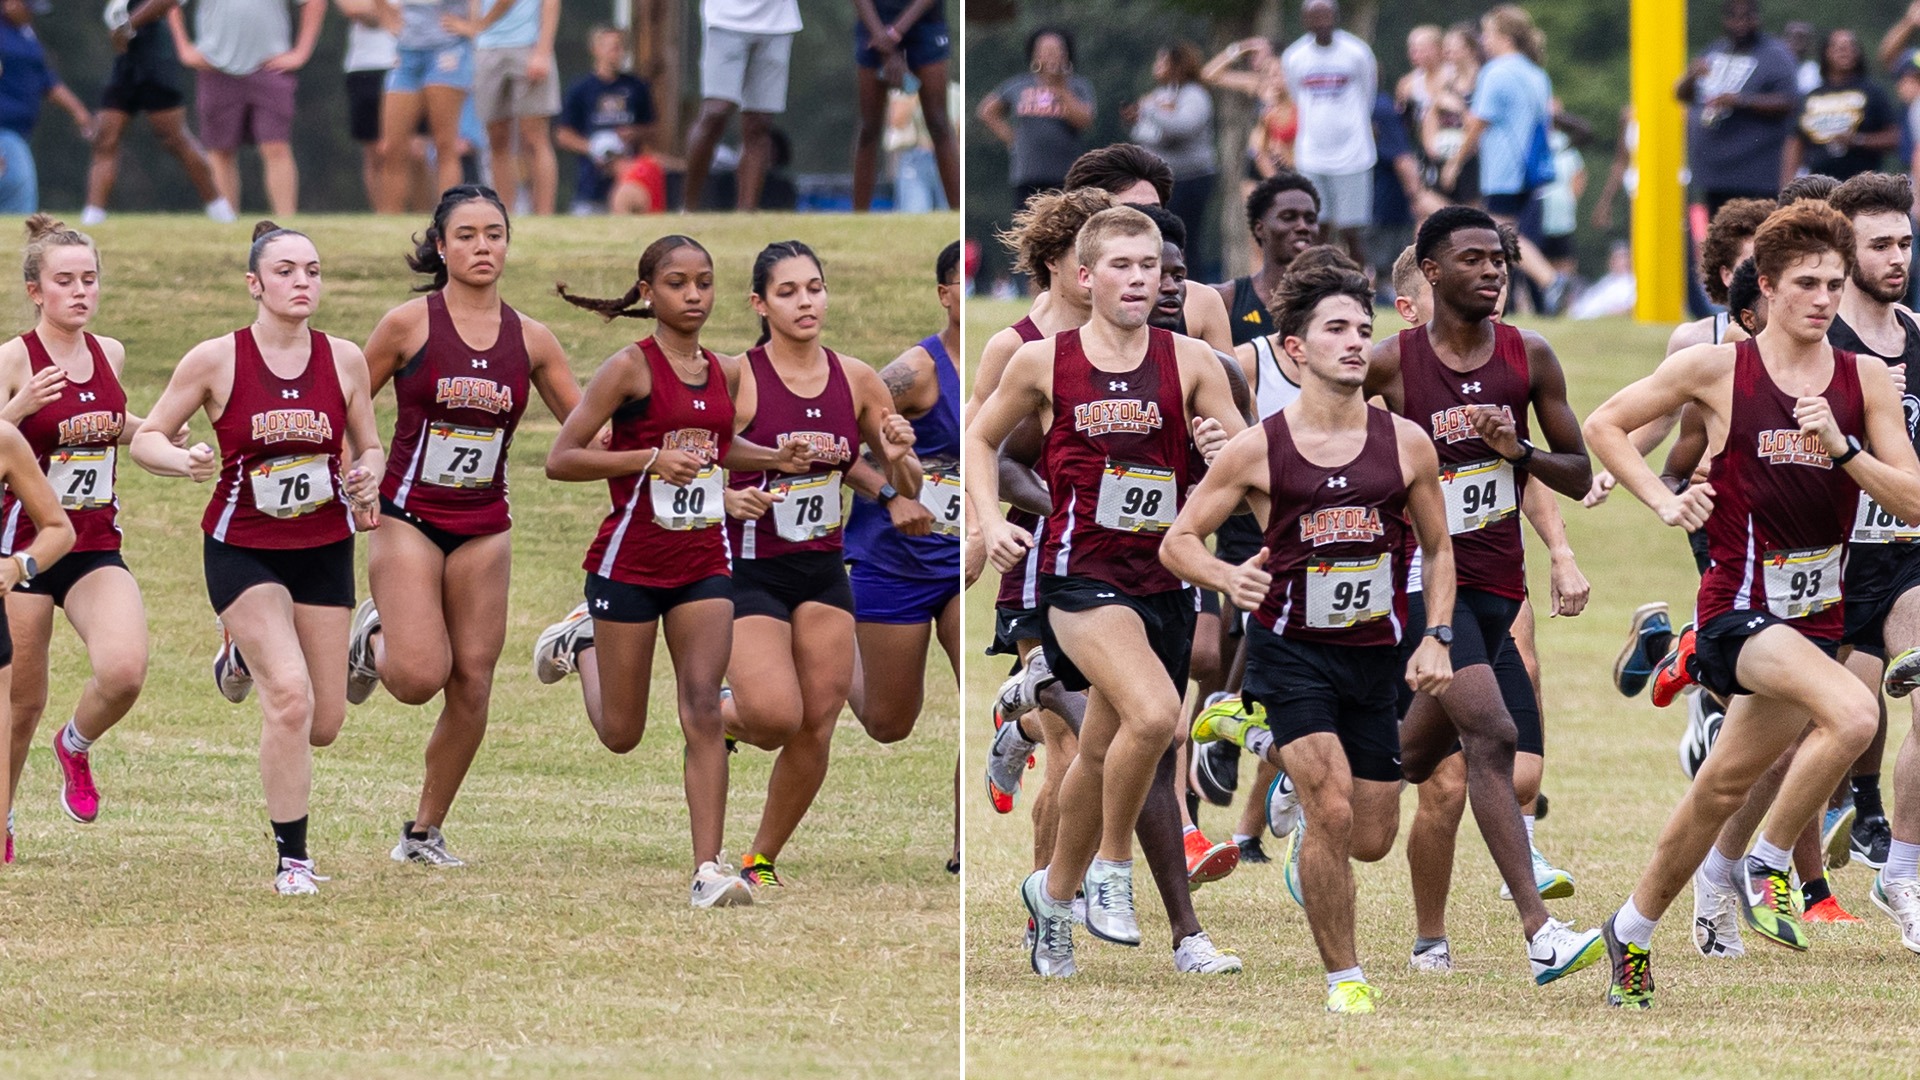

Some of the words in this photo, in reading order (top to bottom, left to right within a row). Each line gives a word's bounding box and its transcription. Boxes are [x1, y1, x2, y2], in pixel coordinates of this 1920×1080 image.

[436, 377, 513, 412] LOYOLA
[252, 409, 332, 440] LOYOLA
[1075, 399, 1162, 432] LOYOLA
[1758, 429, 1829, 457] LOYOL
[447, 447, 483, 474] 73
[67, 469, 97, 495] 79
[279, 473, 310, 505] 76
[1463, 479, 1497, 514] 94
[673, 487, 705, 514] 80
[796, 495, 824, 525] 78
[1122, 487, 1163, 517] 98
[1300, 506, 1384, 542] LOYOLA
[1332, 580, 1371, 611] 95
[1790, 569, 1822, 600] 93
